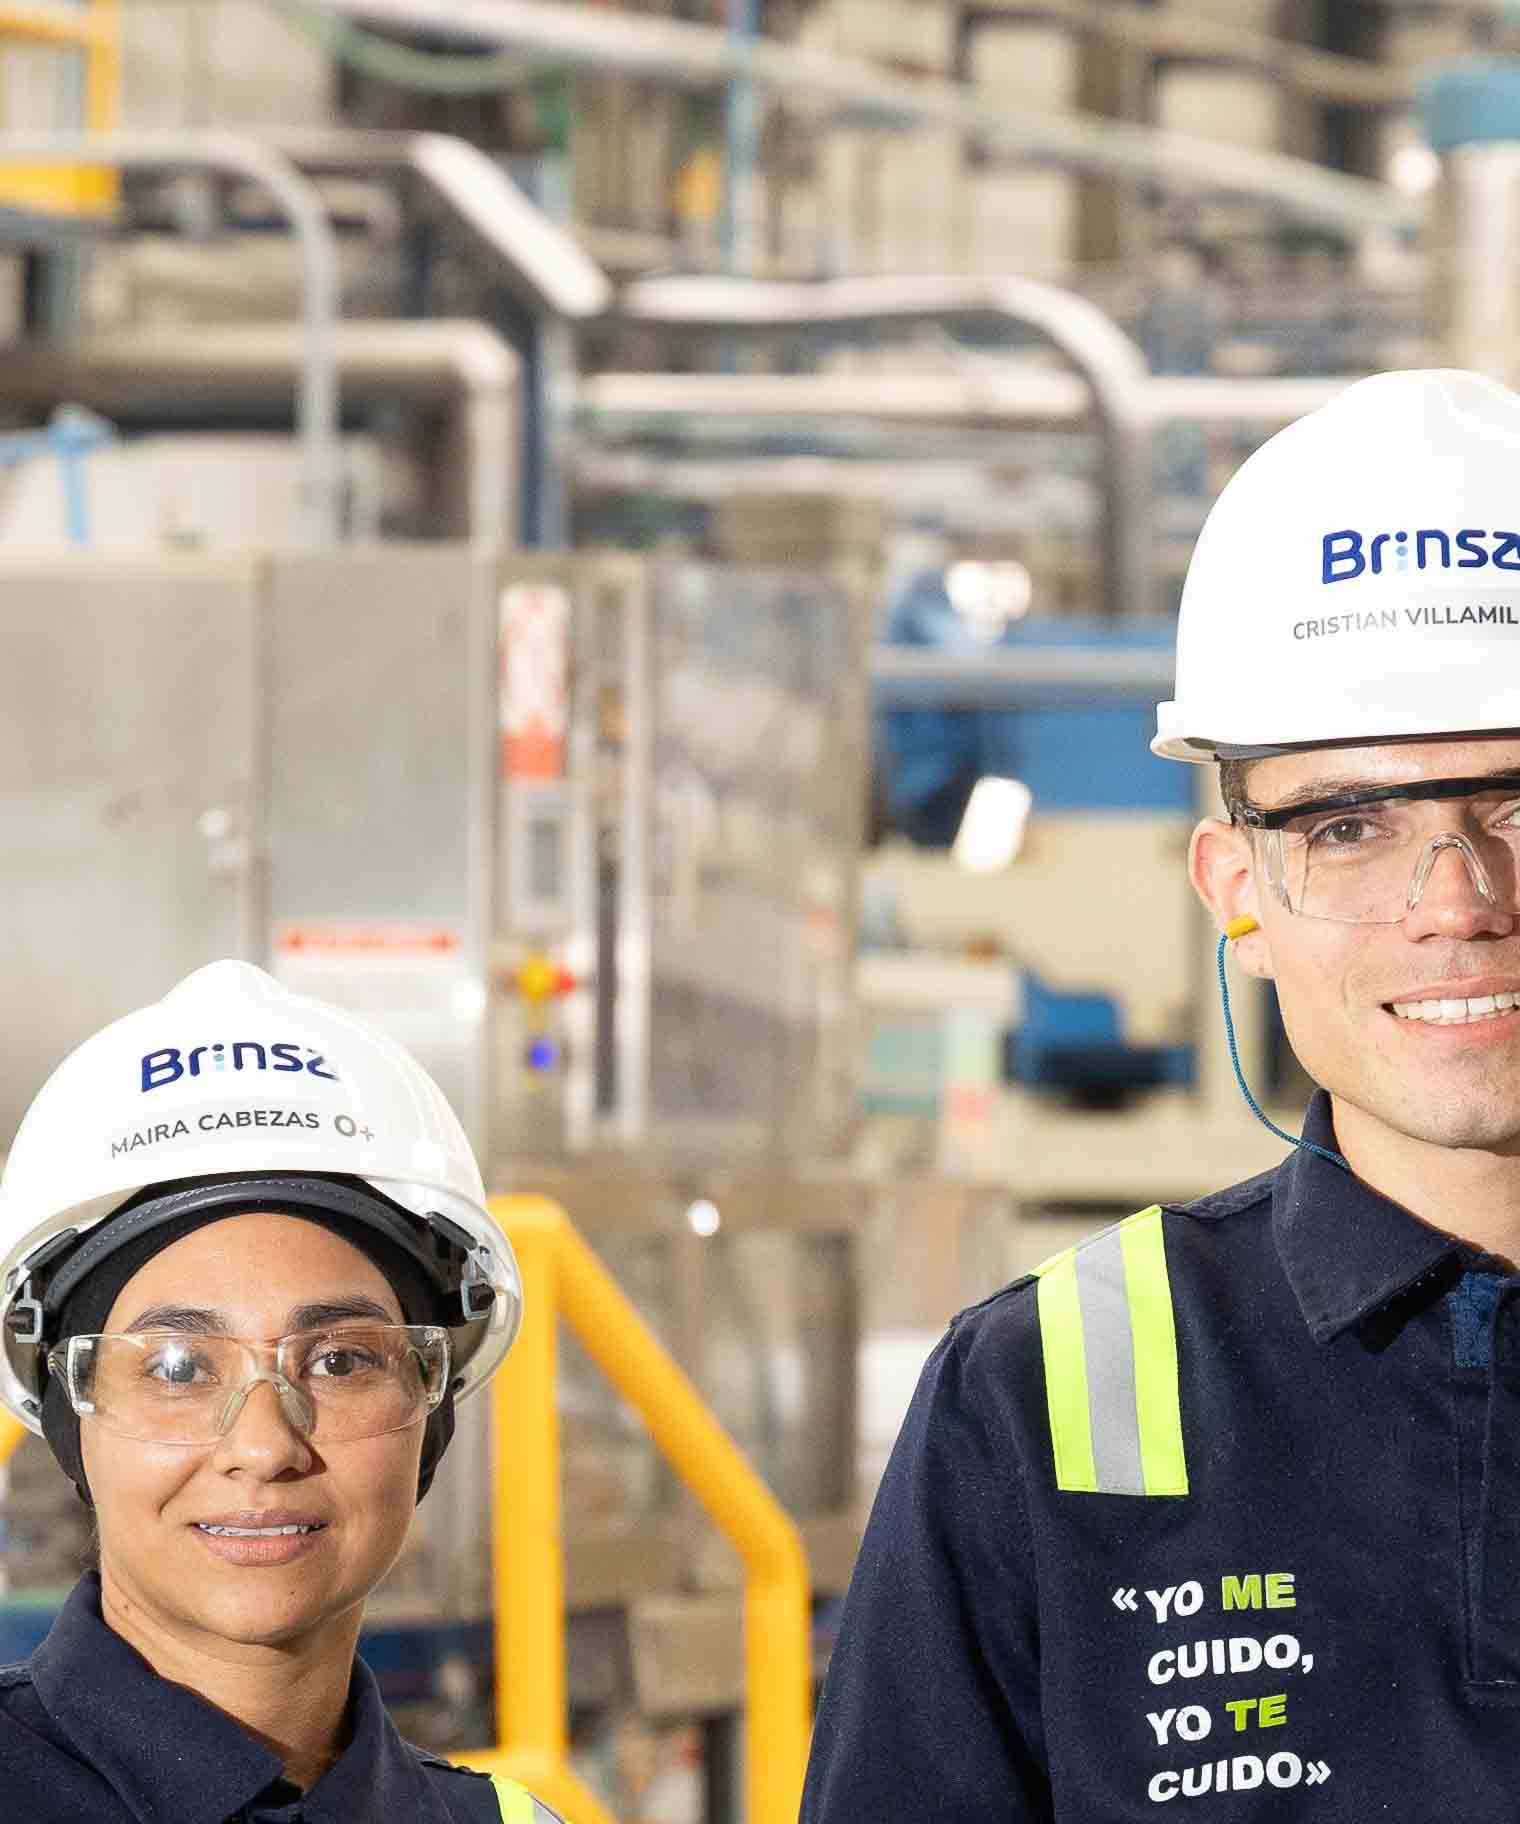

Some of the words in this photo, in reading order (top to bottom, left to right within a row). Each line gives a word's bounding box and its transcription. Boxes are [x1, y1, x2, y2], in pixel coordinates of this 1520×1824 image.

[1293, 609, 1397, 640] CRISTIAN
[1405, 606, 1519, 626] VILLAMIL
[111, 1119, 190, 1158] MAIRA
[198, 1109, 320, 1131] CABEZAS
[1221, 1573, 1297, 1610] ME
[1147, 1634, 1314, 1685] CUIDO,
[1146, 1705, 1212, 1746] YO
[1225, 1694, 1287, 1732] TE
[1147, 1751, 1331, 1802] CUIDO»
